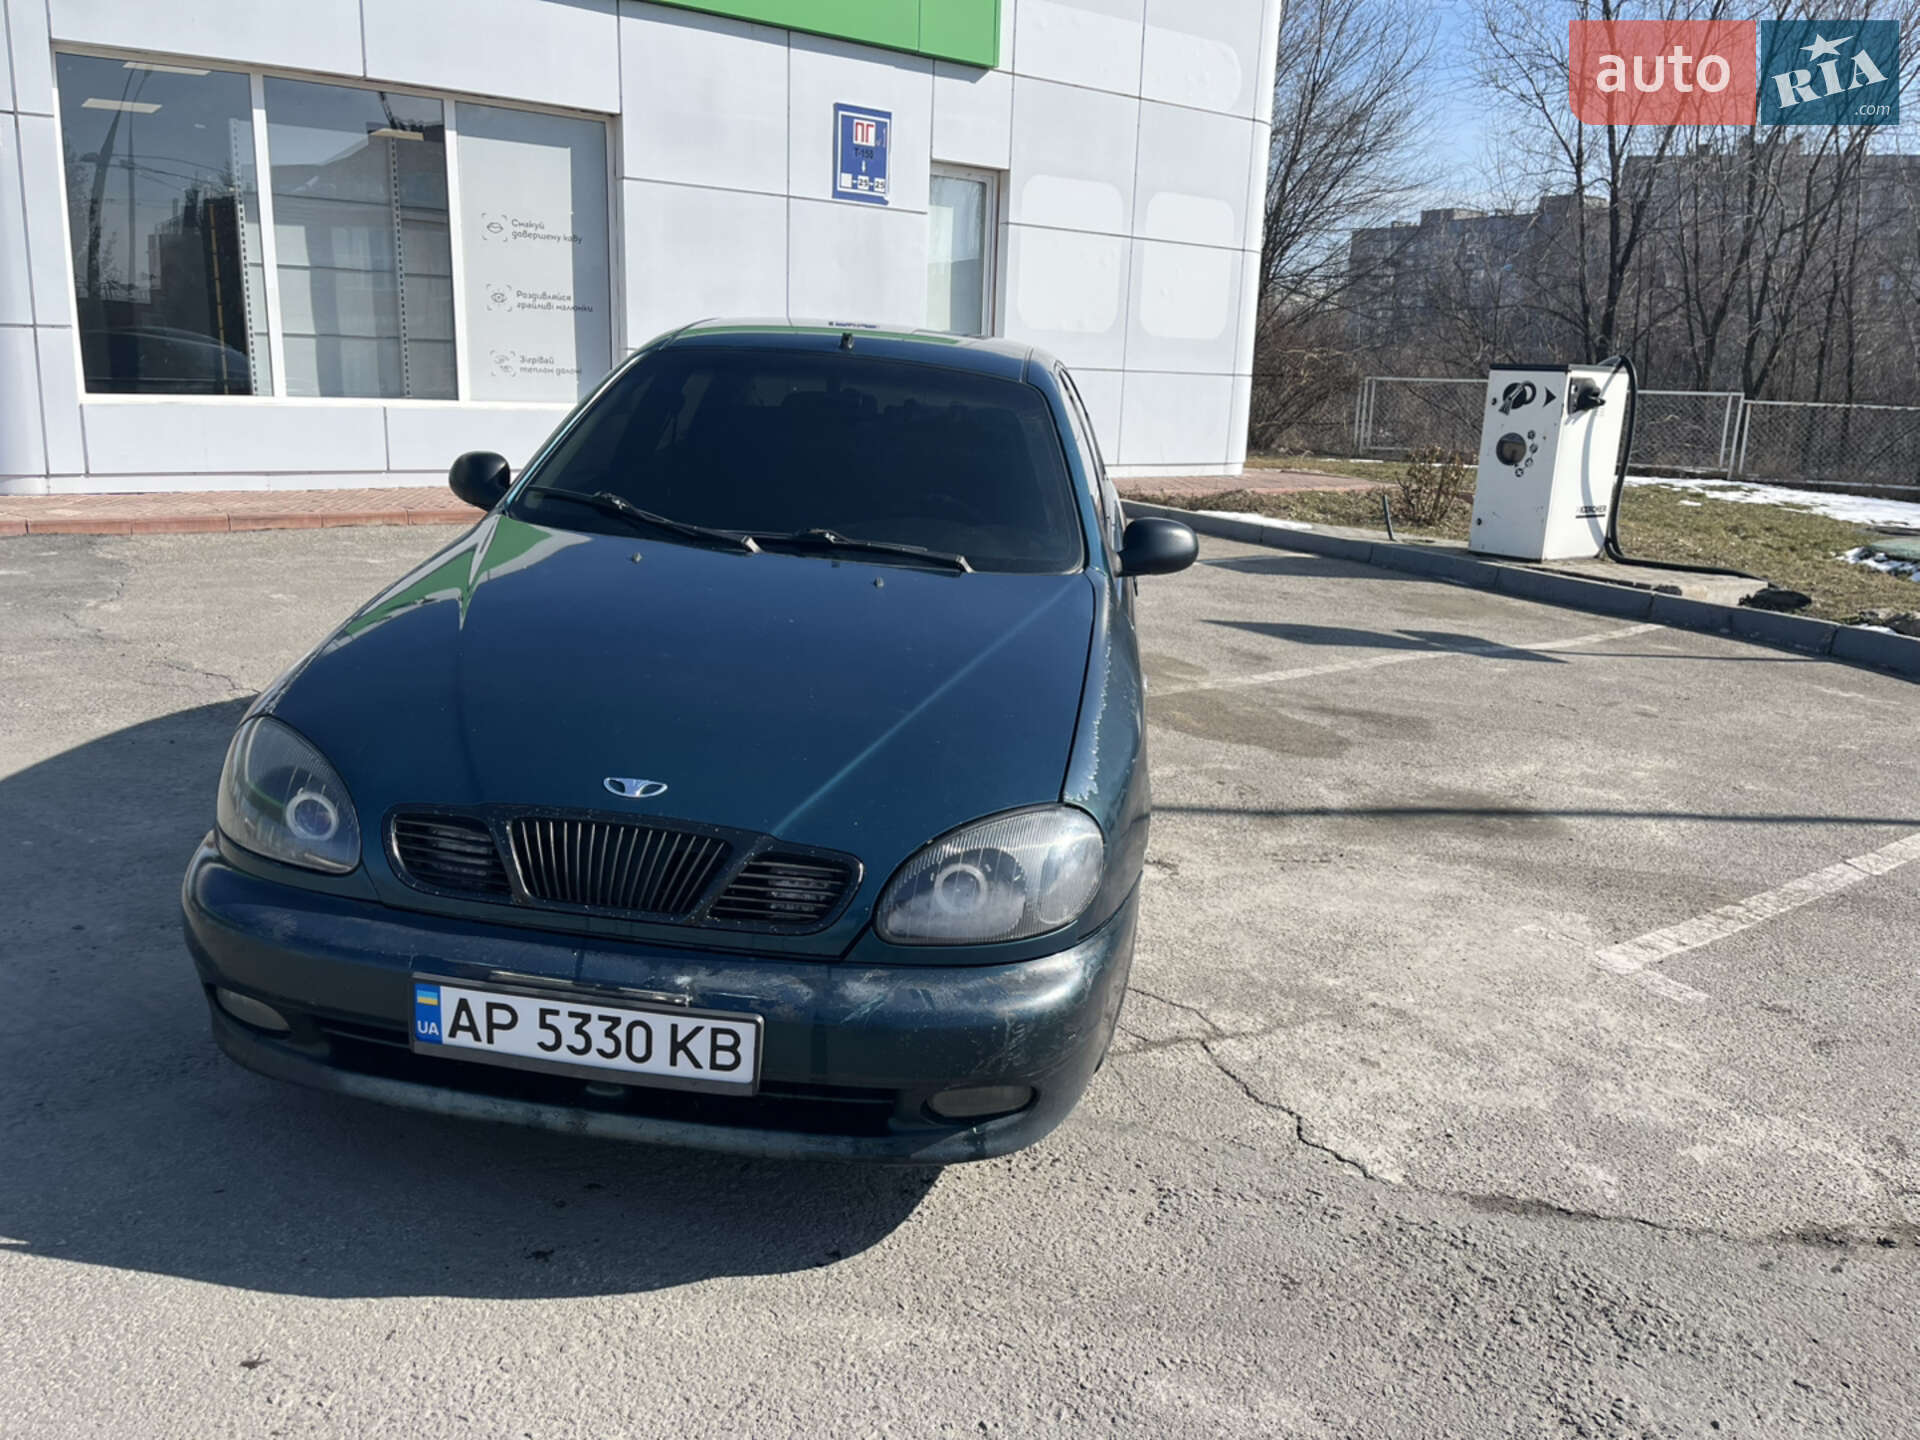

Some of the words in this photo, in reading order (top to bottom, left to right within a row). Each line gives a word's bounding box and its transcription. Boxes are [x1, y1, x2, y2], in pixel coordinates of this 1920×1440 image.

[855, 121, 875, 143] ПГ
[511, 218, 545, 231] Смакуй
[417, 1019, 440, 1037] UA
[448, 998, 519, 1045] AP
[536, 1007, 652, 1064] 5330
[669, 1022, 743, 1072] KB
